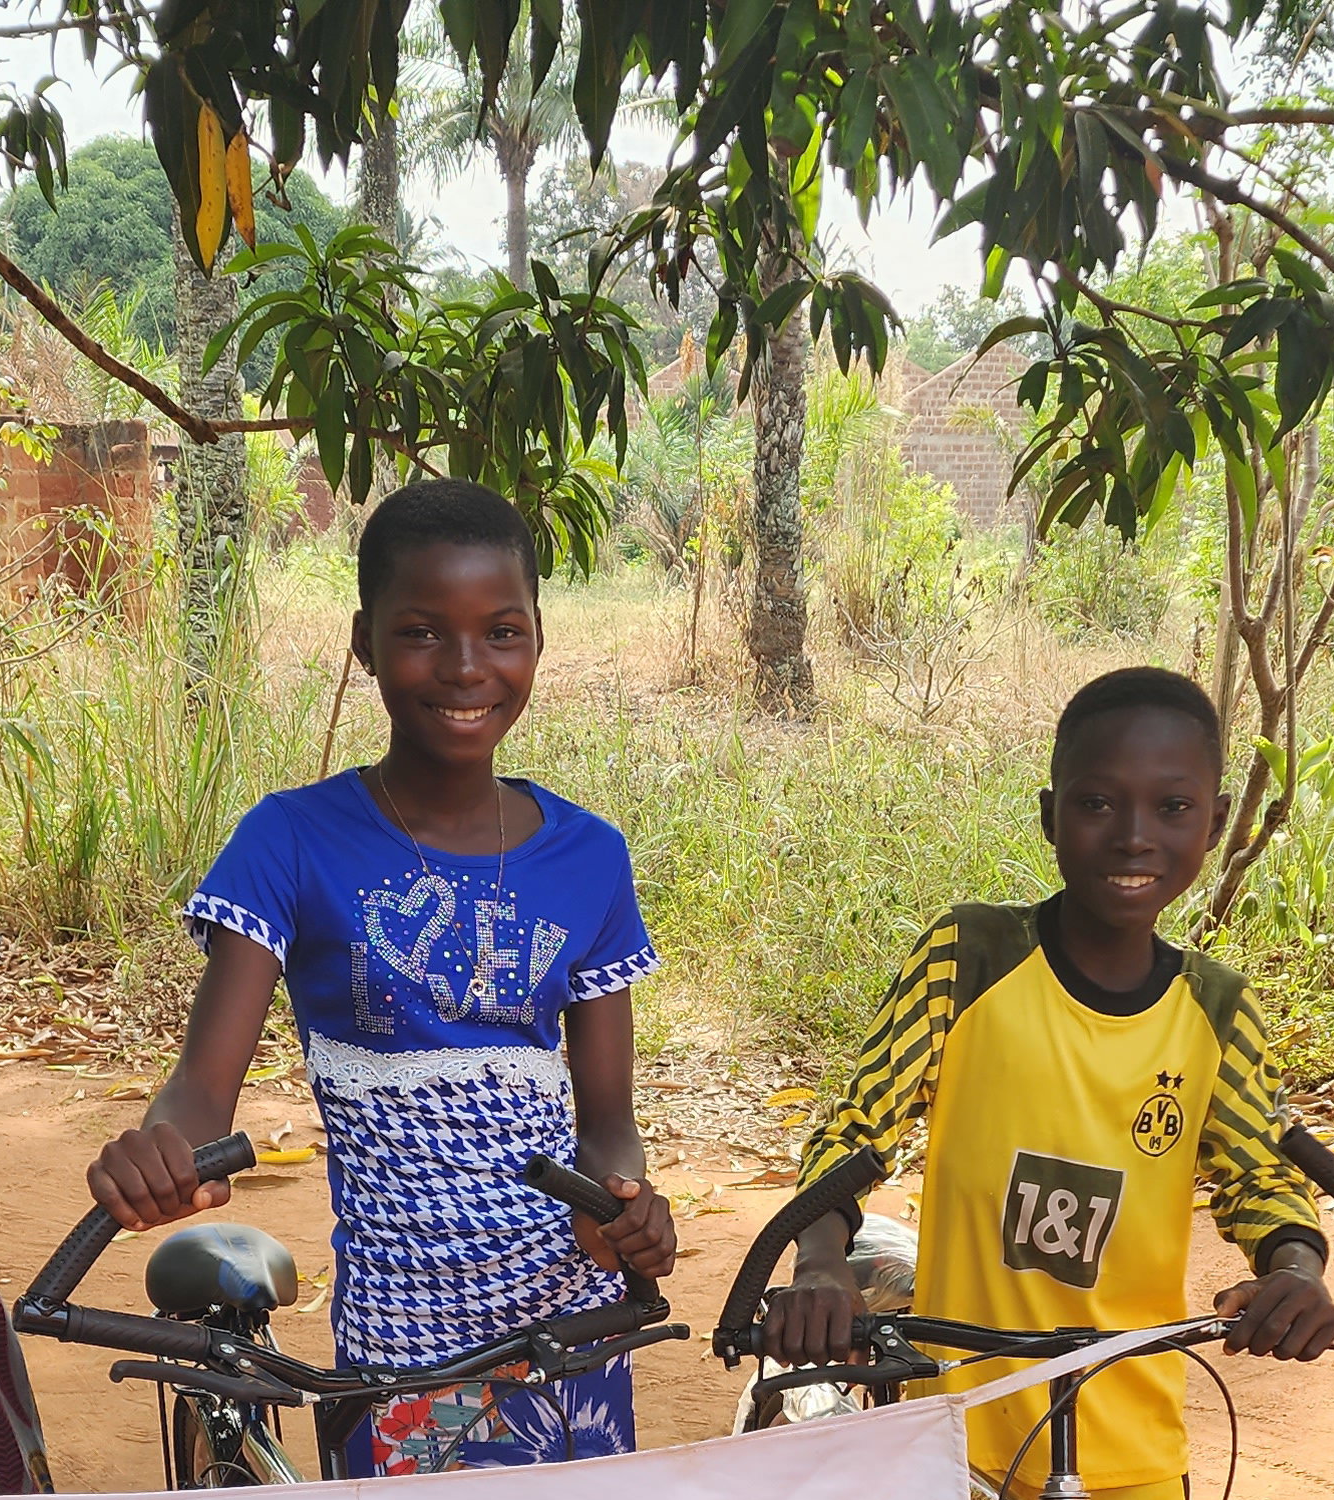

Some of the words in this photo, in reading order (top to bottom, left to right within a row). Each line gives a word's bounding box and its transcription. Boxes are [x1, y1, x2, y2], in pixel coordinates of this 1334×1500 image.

[1136, 1100, 1179, 1136] BVB
[1148, 1135, 1161, 1150] 09
[1014, 1181, 1112, 1264] 1&1
